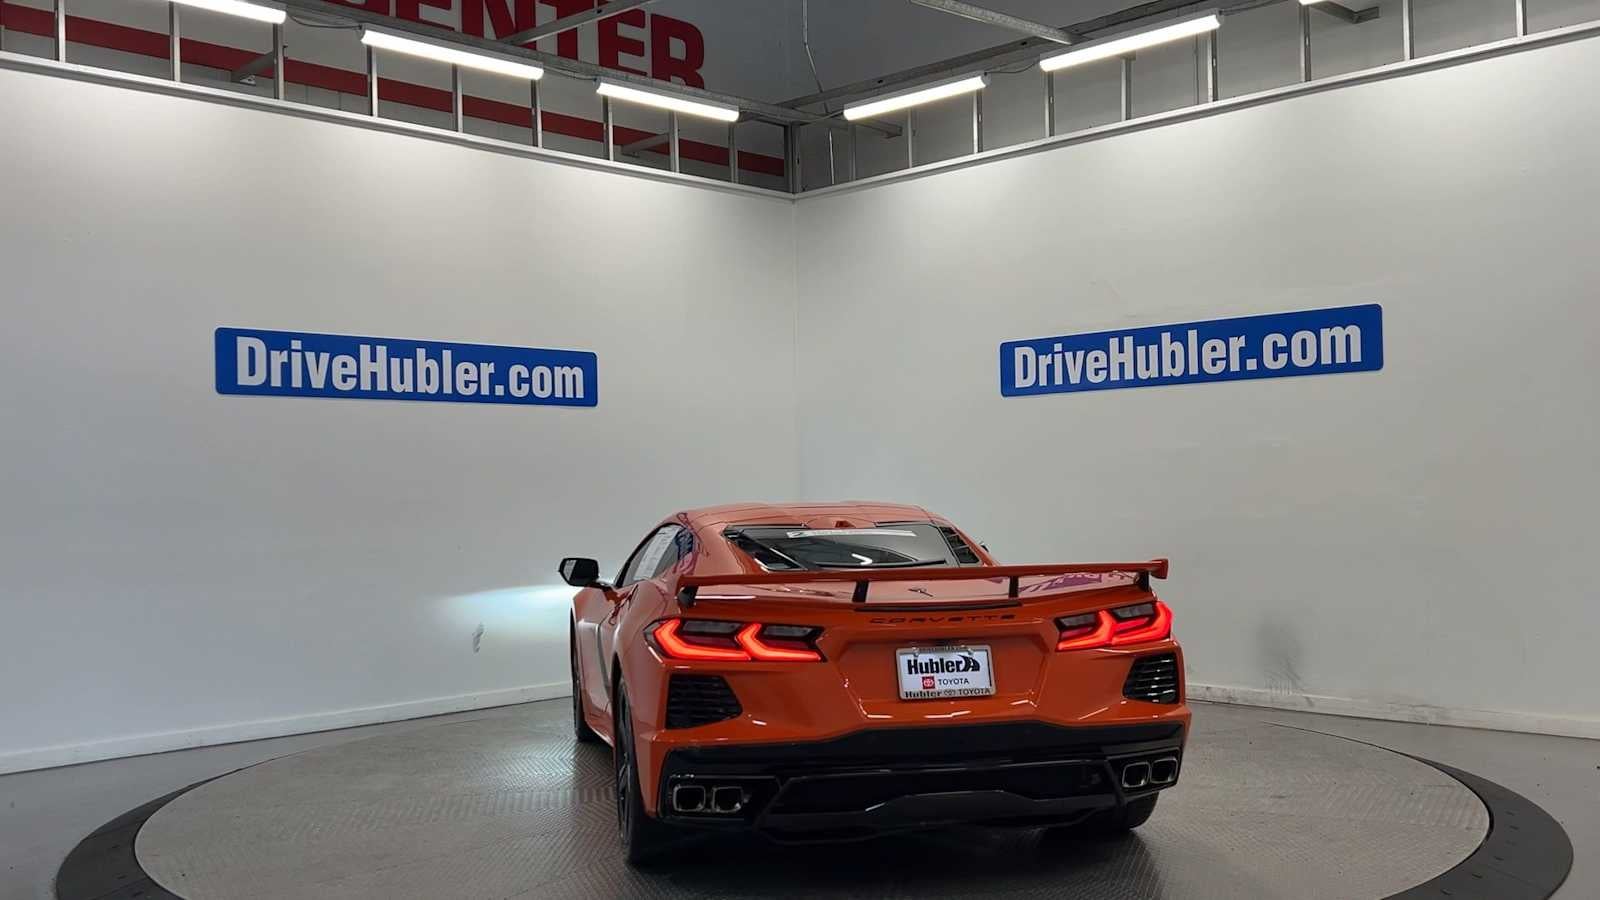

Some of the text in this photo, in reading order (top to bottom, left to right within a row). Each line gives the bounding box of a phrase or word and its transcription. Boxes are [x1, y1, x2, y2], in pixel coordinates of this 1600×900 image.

[1014, 324, 1362, 389] DriveHubler.com
[236, 336, 584, 399] DriveHubler.com
[869, 614, 1016, 624] CORVETTE
[907, 657, 963, 675] Hubler
[938, 678, 969, 686] TOYOTA
[905, 687, 990, 698] Hubler TOYOTA
